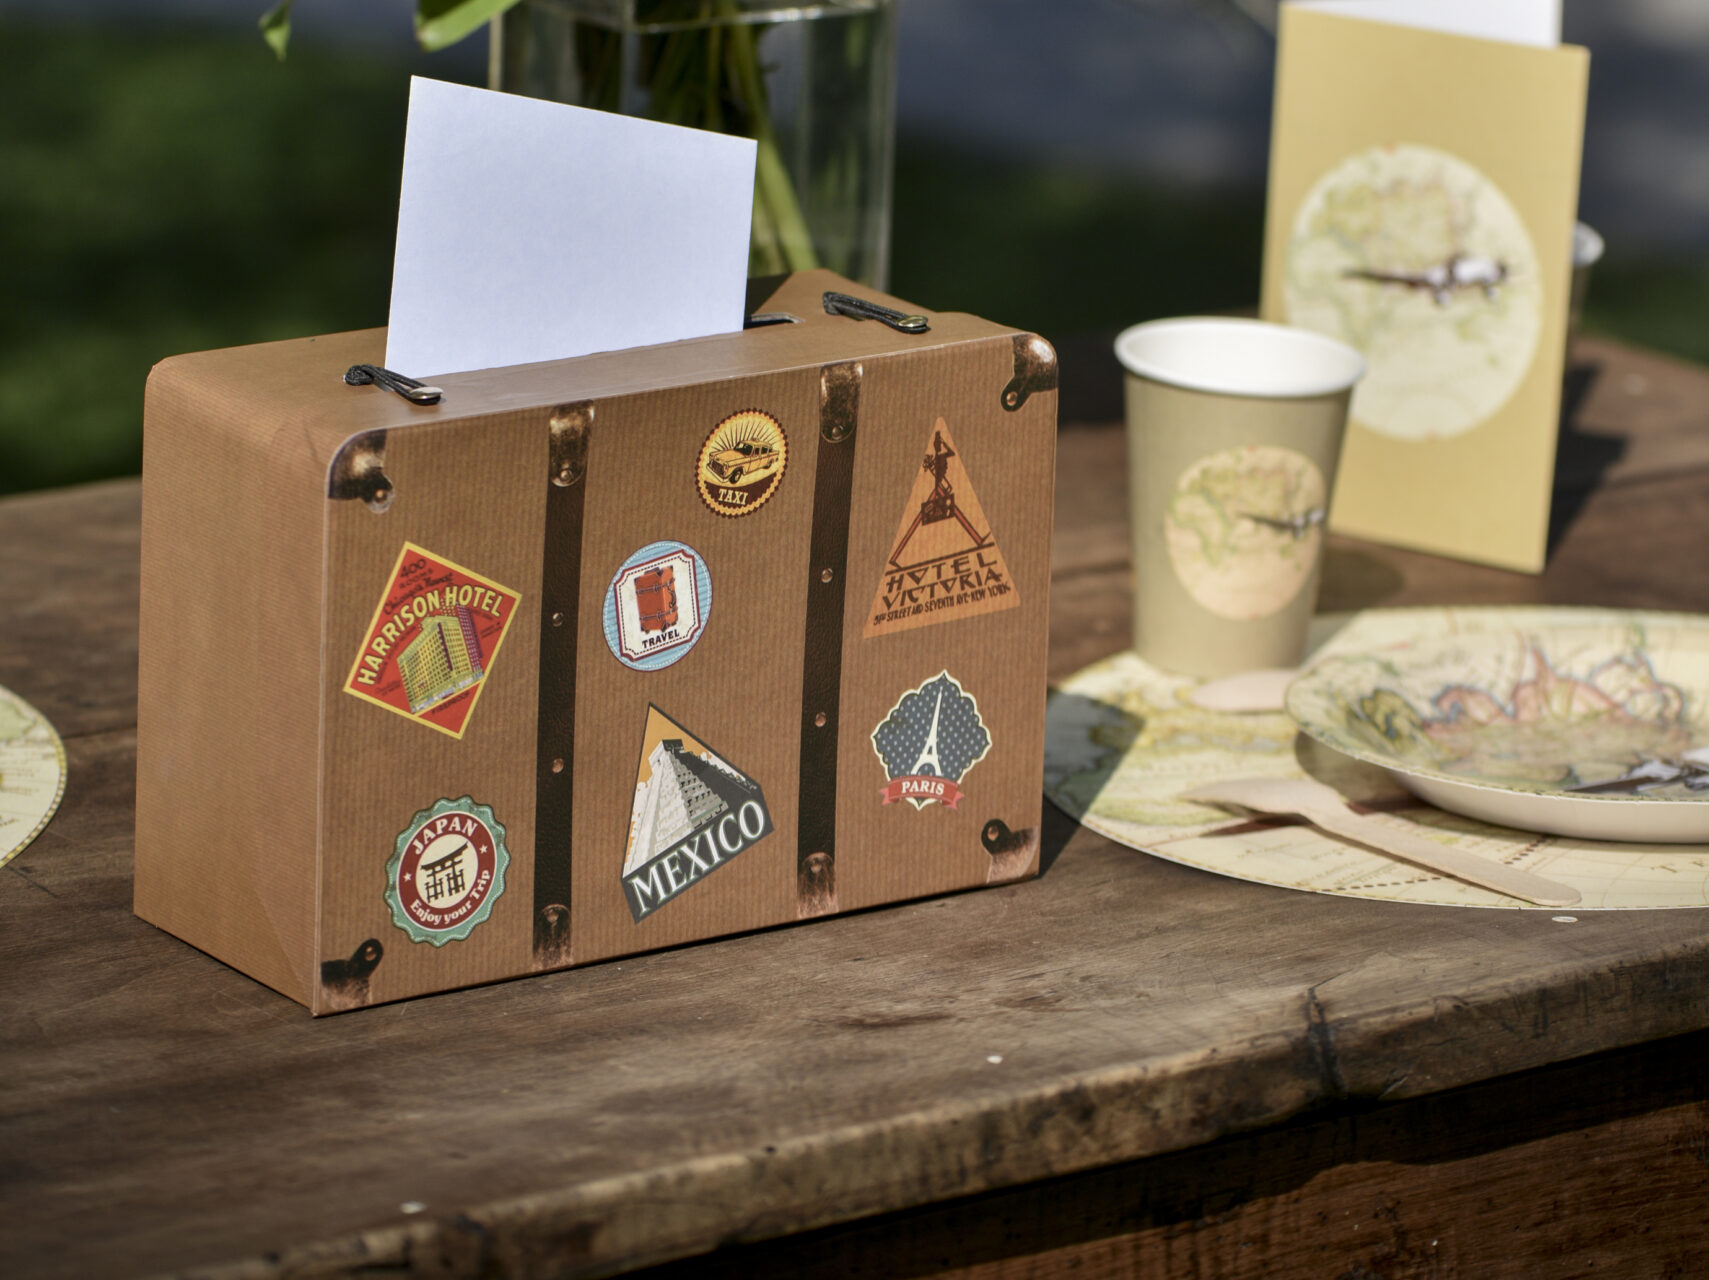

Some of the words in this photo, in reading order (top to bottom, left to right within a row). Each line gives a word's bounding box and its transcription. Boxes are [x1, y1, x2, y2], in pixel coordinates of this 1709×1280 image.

[717, 488, 749, 505] TAXI
[882, 567, 1003, 611] VICTORIA
[886, 552, 998, 593] HOTEL
[887, 606, 912, 622] STREET
[924, 595, 954, 613] SEVENTH
[987, 581, 1012, 598] YORK
[357, 589, 441, 685] HARRISON
[445, 584, 504, 617] HOTEL
[641, 629, 680, 649] TRAVEL
[901, 780, 945, 795] PARIS
[412, 816, 478, 855] JAPAN
[629, 801, 765, 917] MEXICO
[410, 899, 442, 926] Enjoy
[444, 900, 473, 925] your
[470, 869, 491, 901] Trip
